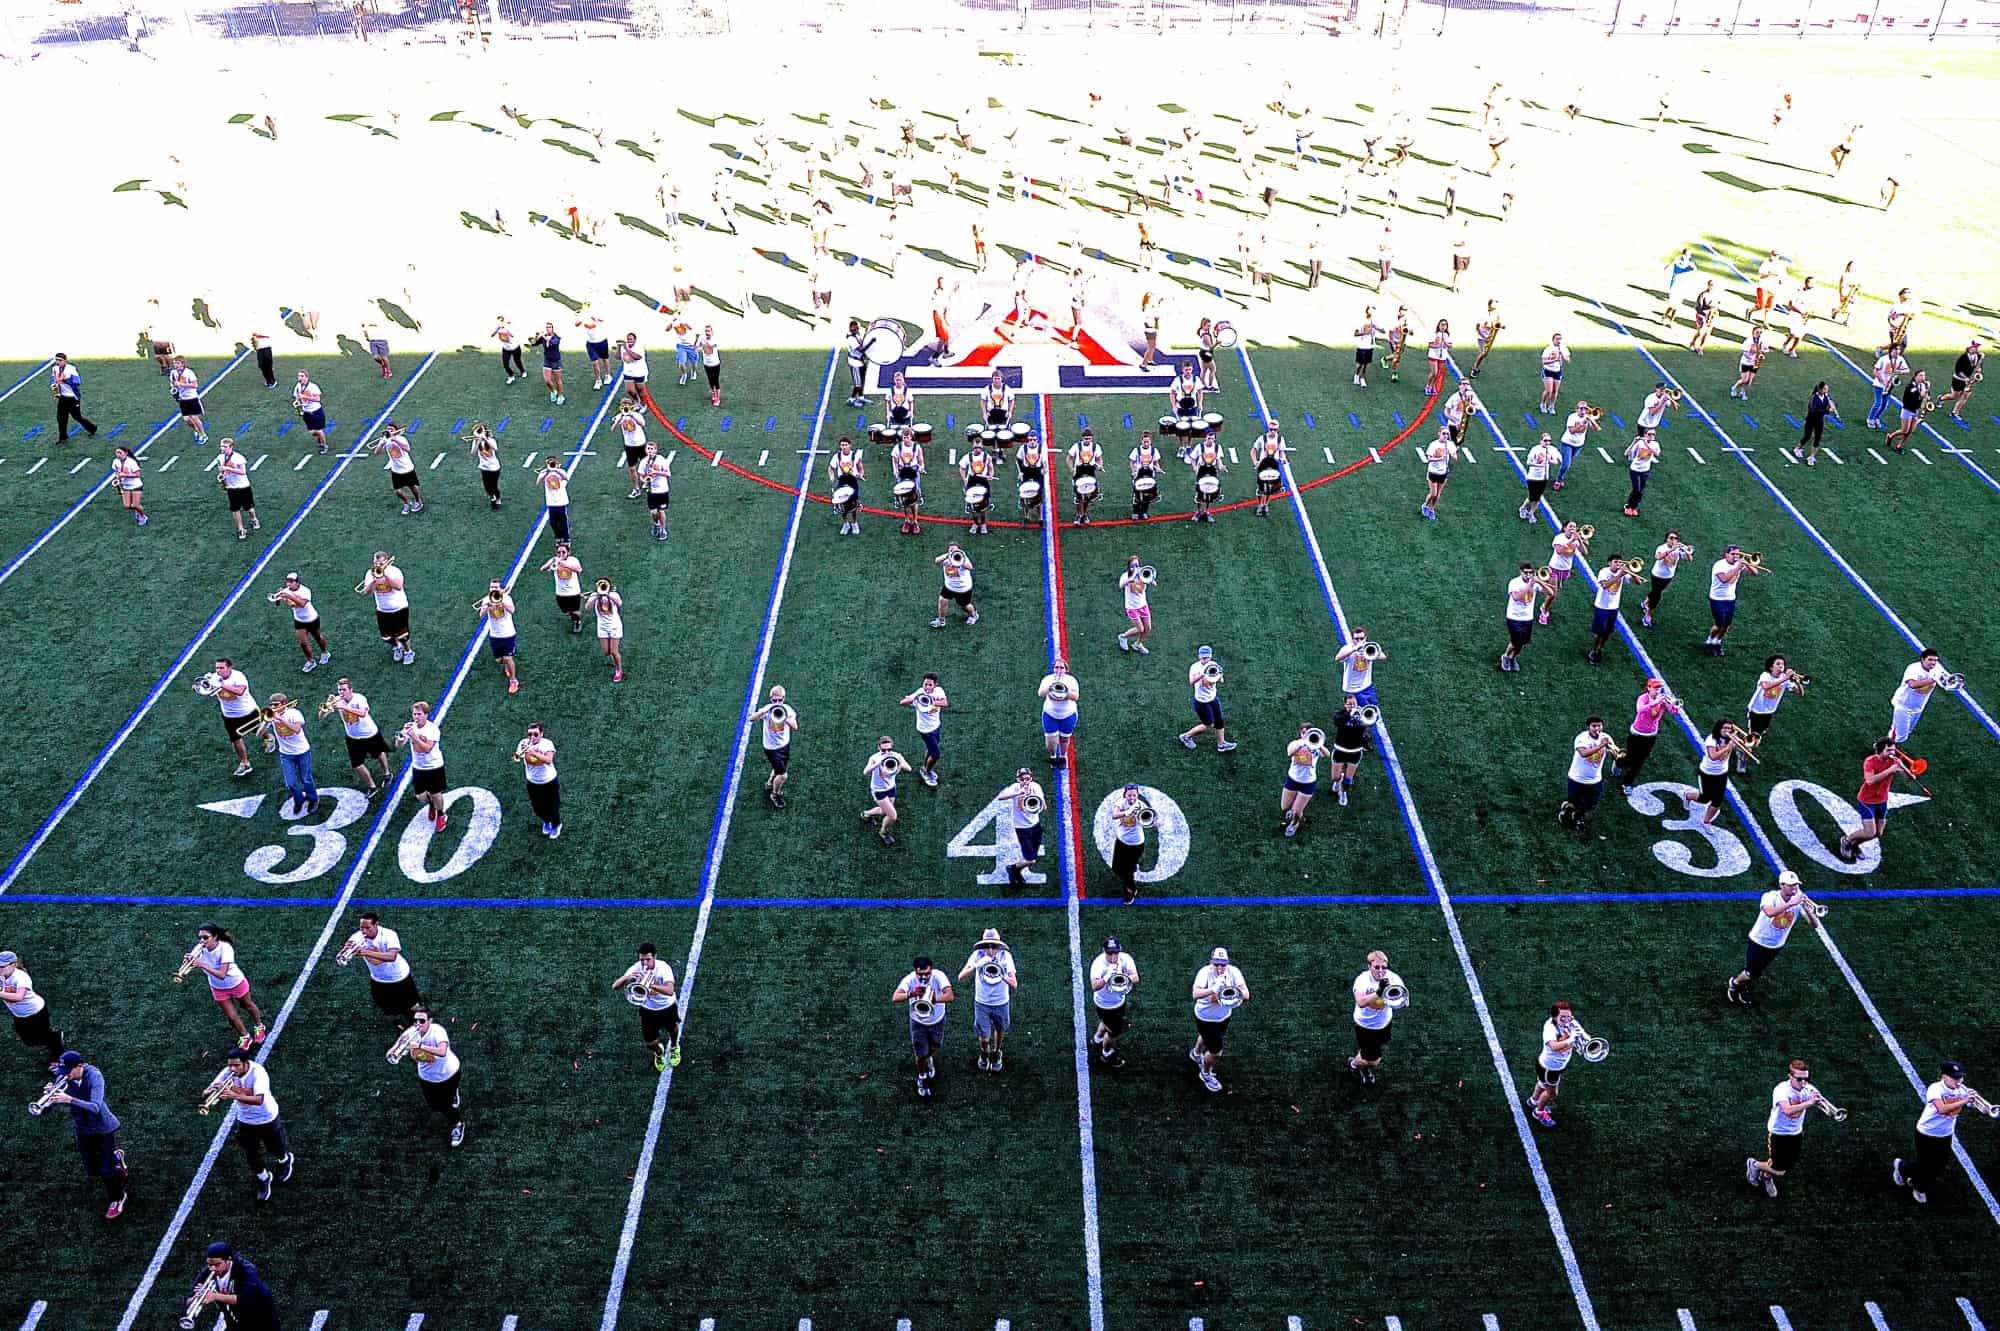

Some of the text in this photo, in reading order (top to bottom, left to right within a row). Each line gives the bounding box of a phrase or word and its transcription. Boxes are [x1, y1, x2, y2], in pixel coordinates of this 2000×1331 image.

[244, 787, 501, 884] 30
[947, 785, 1191, 884] 40
[1627, 779, 1882, 878] 30
